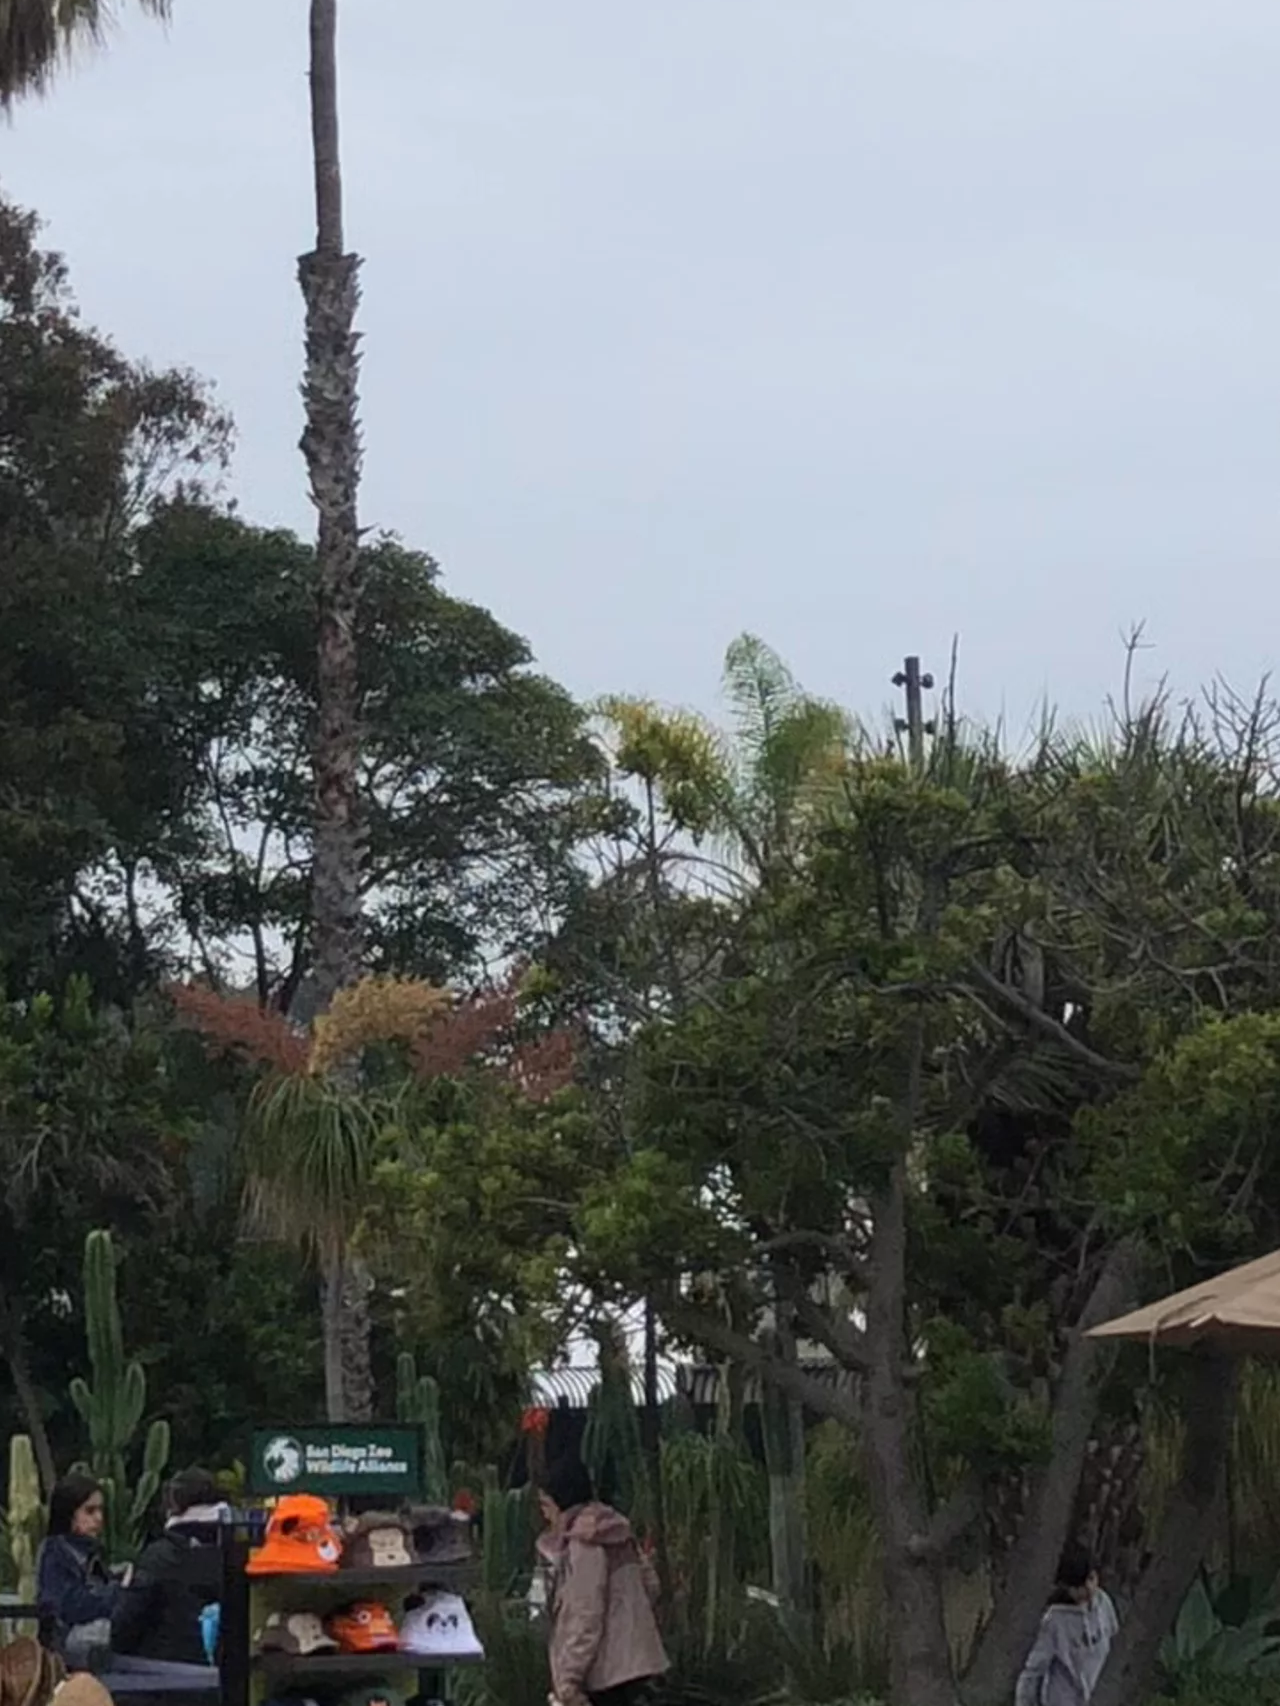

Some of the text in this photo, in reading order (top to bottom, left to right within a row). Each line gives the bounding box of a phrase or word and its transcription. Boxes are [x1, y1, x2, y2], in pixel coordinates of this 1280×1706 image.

[306, 1443, 393, 1462] San Diego Zoo
[306, 1459, 408, 1474] Wildlife Alliance
